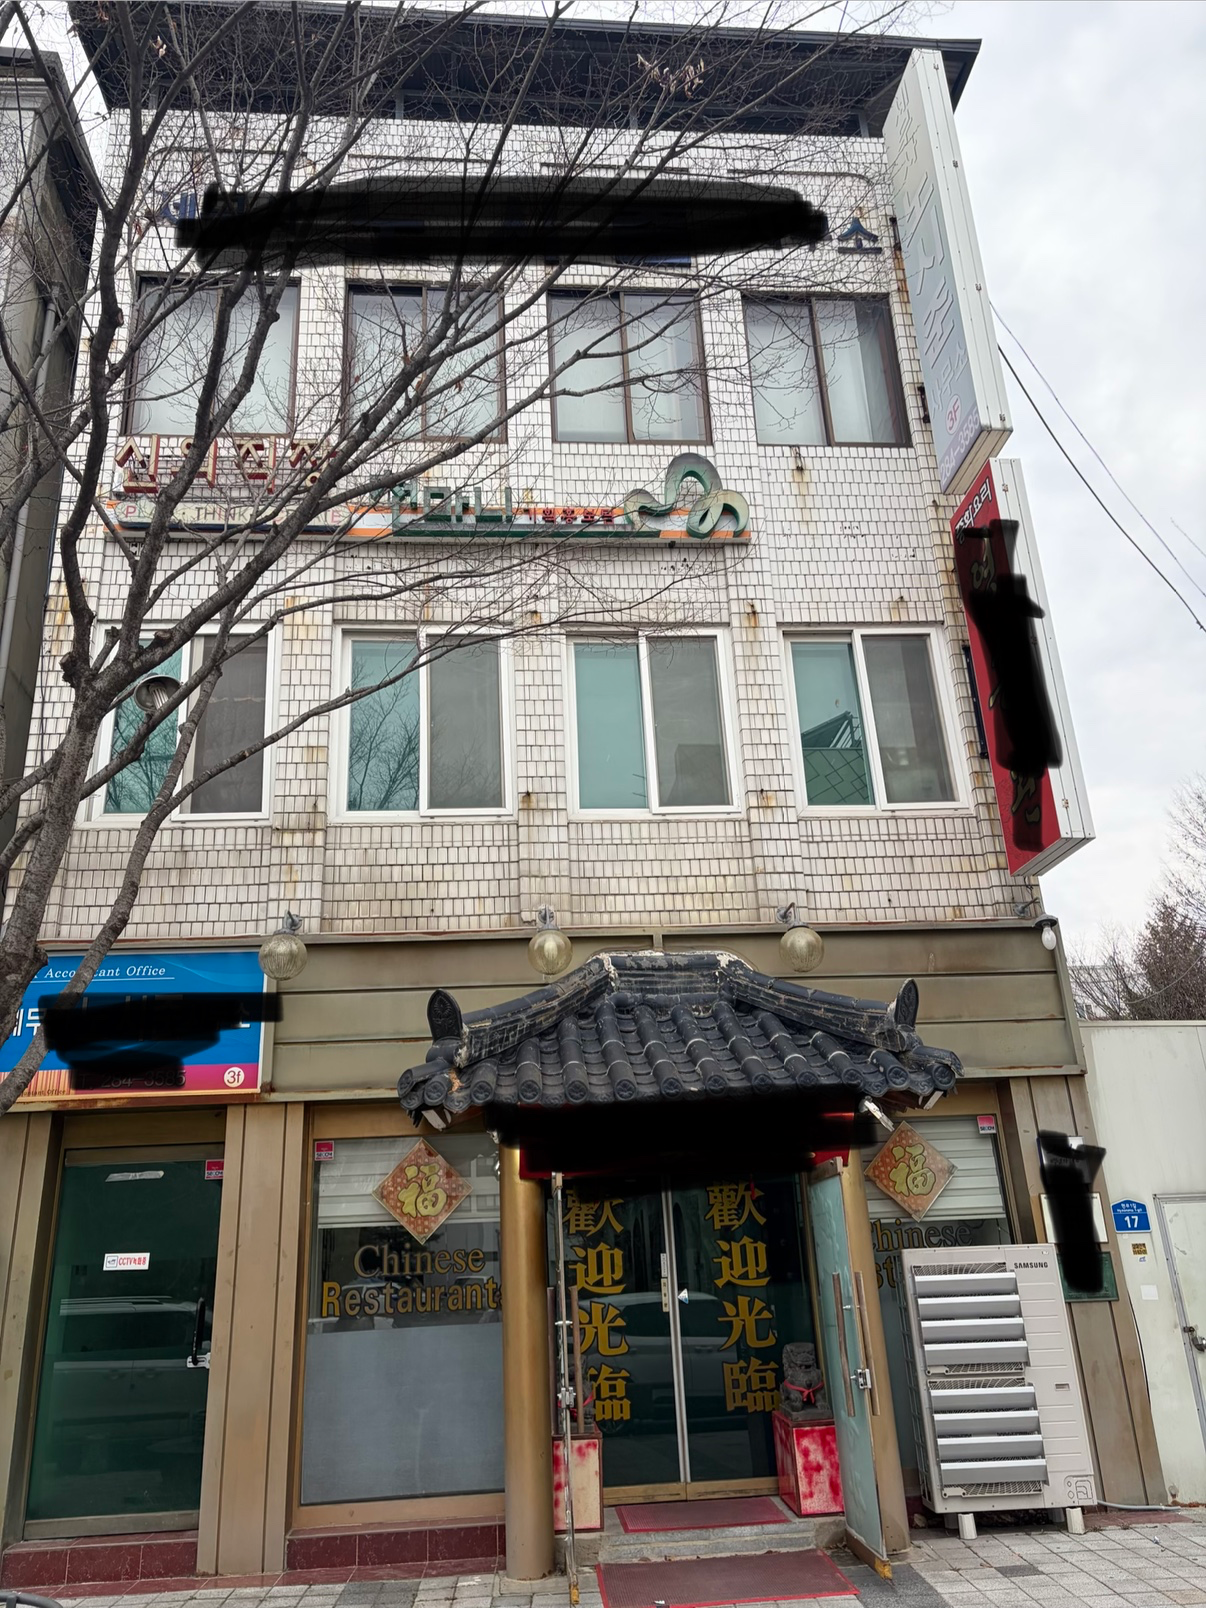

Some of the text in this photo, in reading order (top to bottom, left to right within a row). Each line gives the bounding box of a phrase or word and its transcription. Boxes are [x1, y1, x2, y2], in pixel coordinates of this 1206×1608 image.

[946, 397, 960, 428] 3F
[939, 408, 980, 488] 284-3585
[44, 967, 121, 979] Accotant
[126, 965, 166, 977] Office
[226, 1071, 242, 1085] 3f
[889, 1143, 937, 1197] 福
[398, 1163, 448, 1218] 福
[871, 1218, 974, 1252] hinese
[1124, 1215, 1139, 1229] 17
[353, 1244, 486, 1278] Chinese
